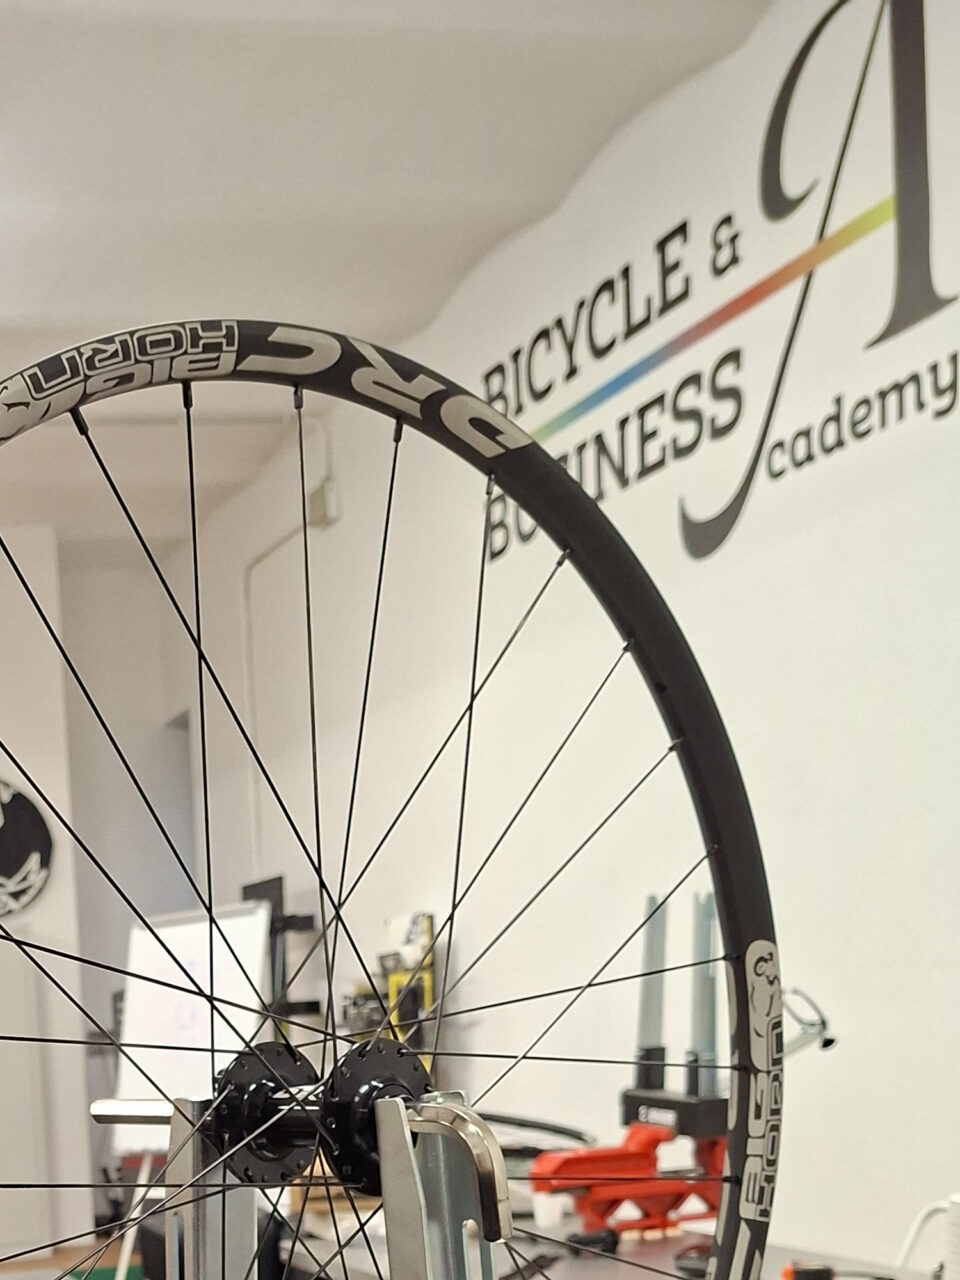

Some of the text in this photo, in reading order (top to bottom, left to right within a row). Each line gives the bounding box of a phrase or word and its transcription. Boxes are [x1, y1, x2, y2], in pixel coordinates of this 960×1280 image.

[21, 320, 239, 399] HORN
[85, 351, 238, 402] BIG
[483, 212, 741, 417] BICYCLE &
[237, 328, 533, 458] DRC
[488, 347, 745, 561] BUINESS
